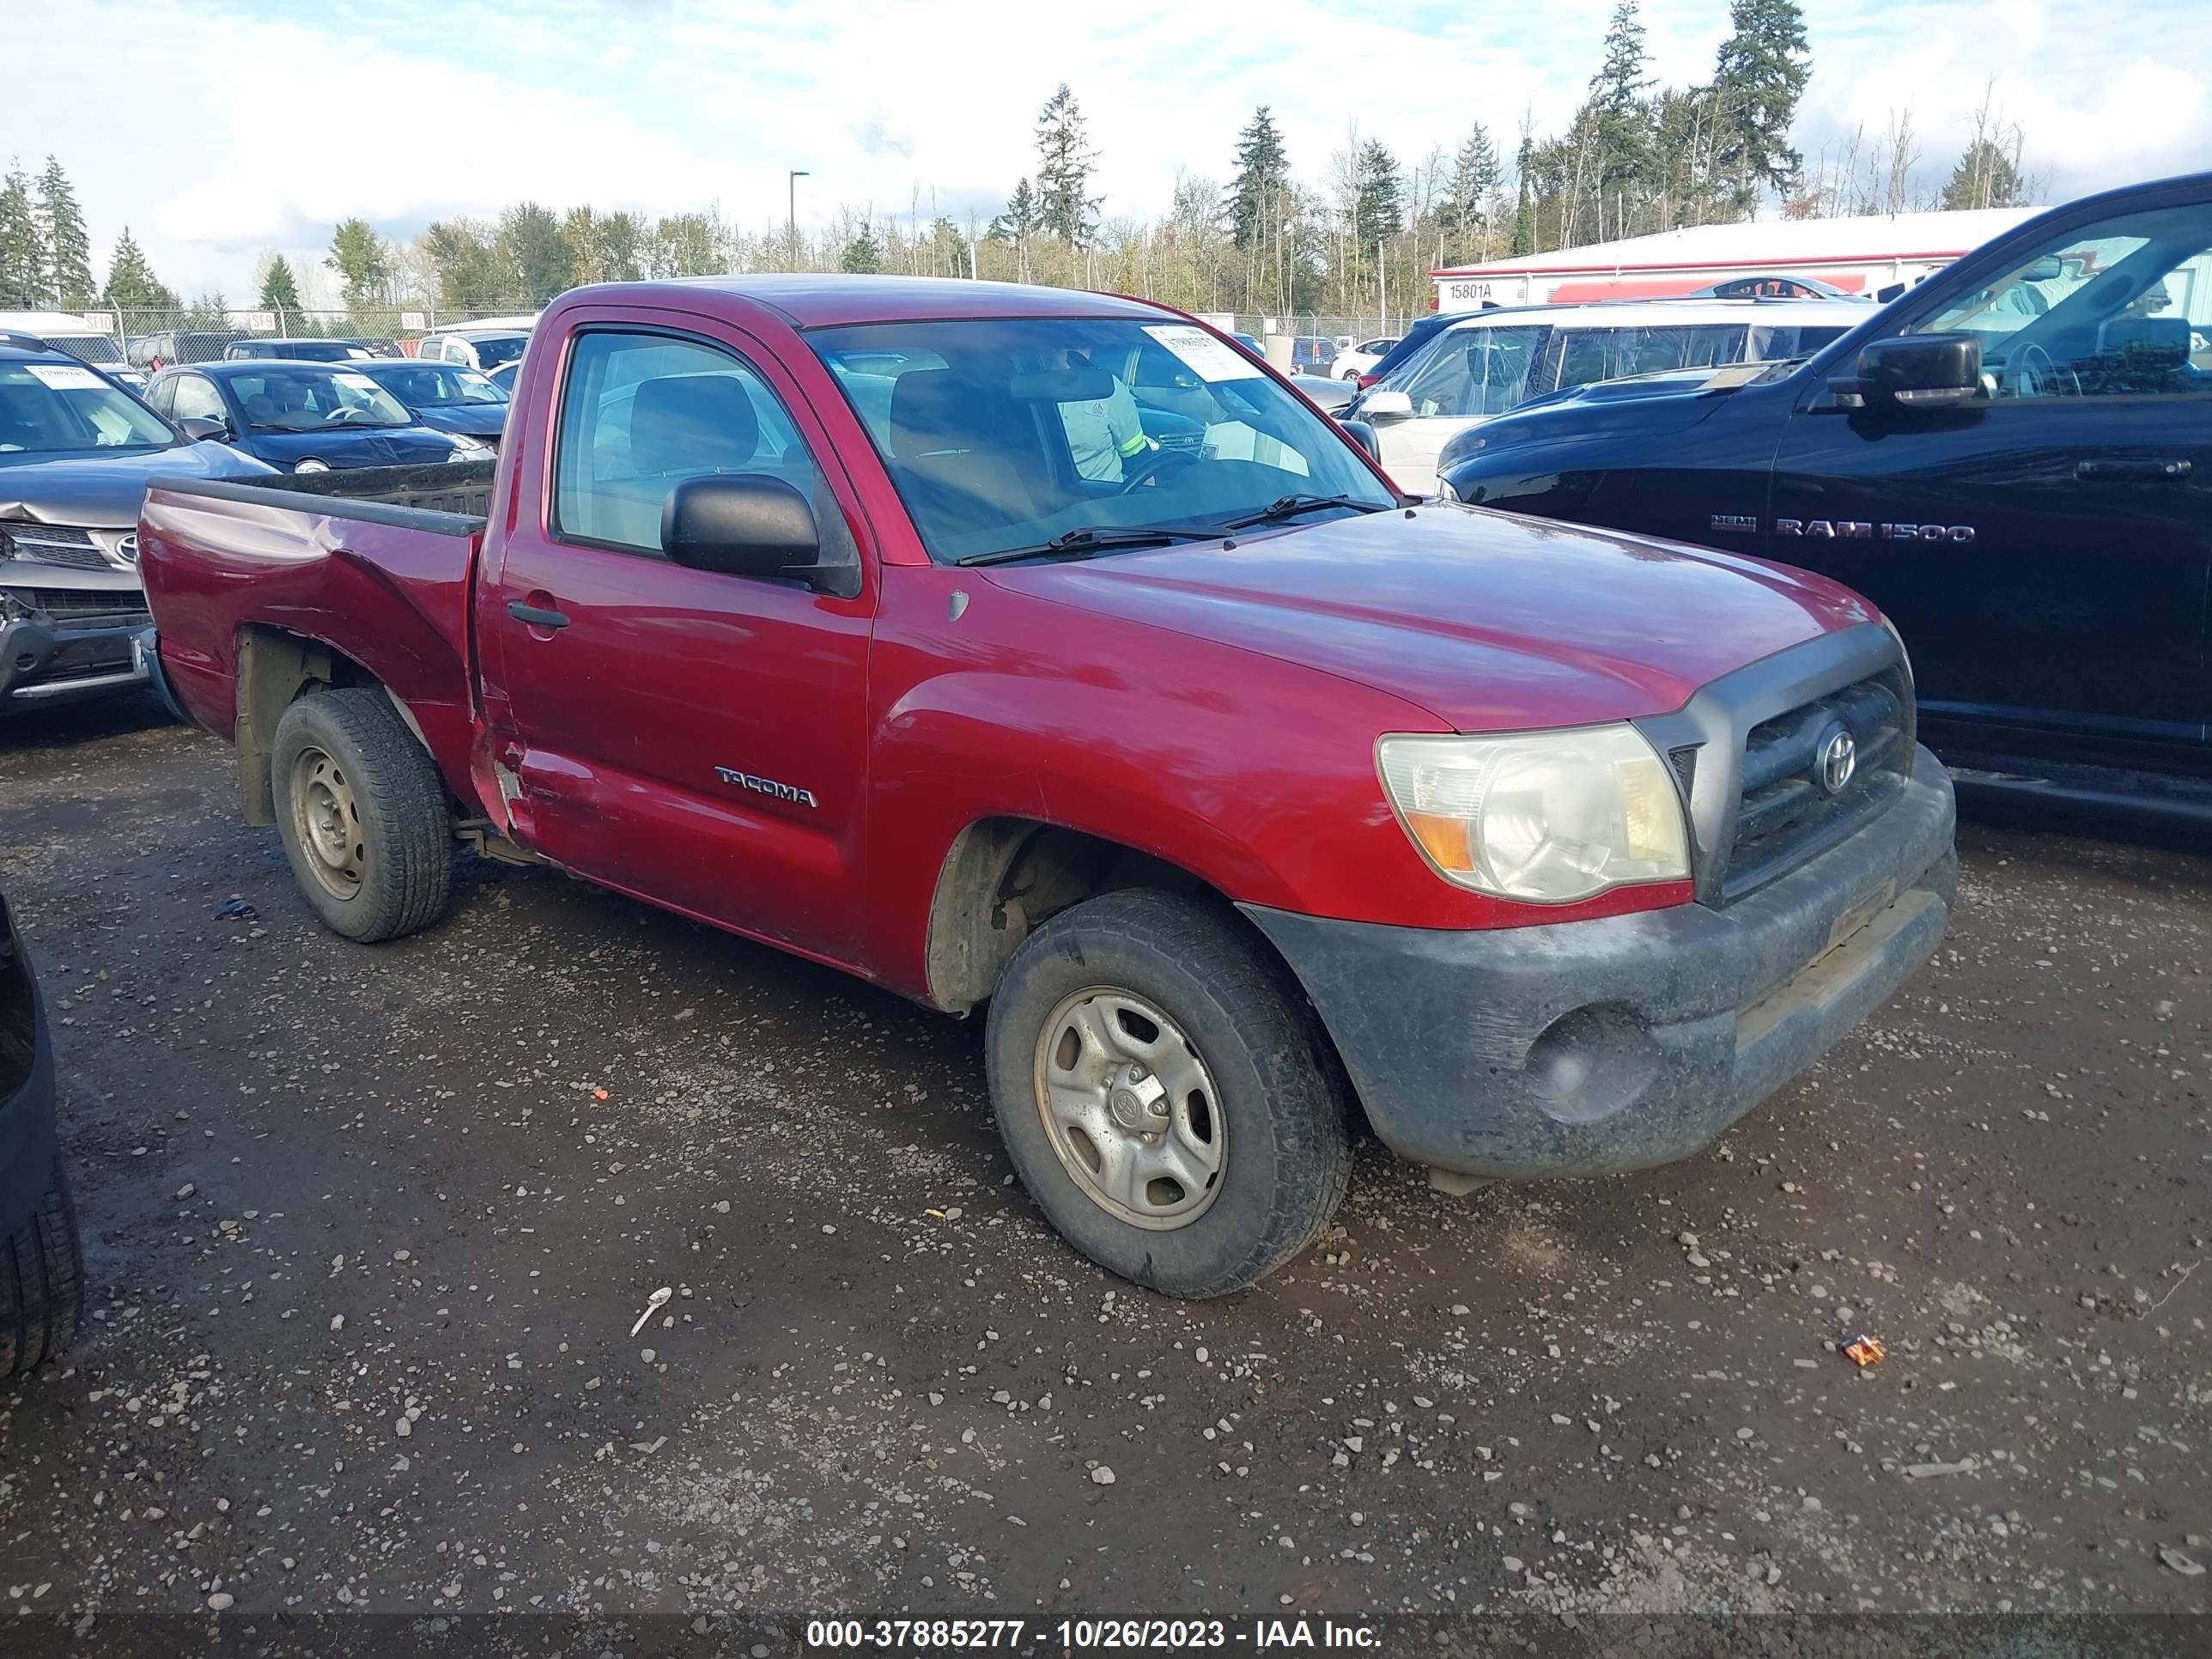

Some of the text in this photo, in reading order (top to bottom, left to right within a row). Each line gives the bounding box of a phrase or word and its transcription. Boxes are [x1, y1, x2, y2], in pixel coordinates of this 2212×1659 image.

[1449, 283, 1492, 299] 15801A
[86, 315, 112, 330] SF10
[252, 314, 273, 327] SF9
[1777, 519, 1976, 544] RAM 1500
[714, 766, 820, 808] TACOMA
